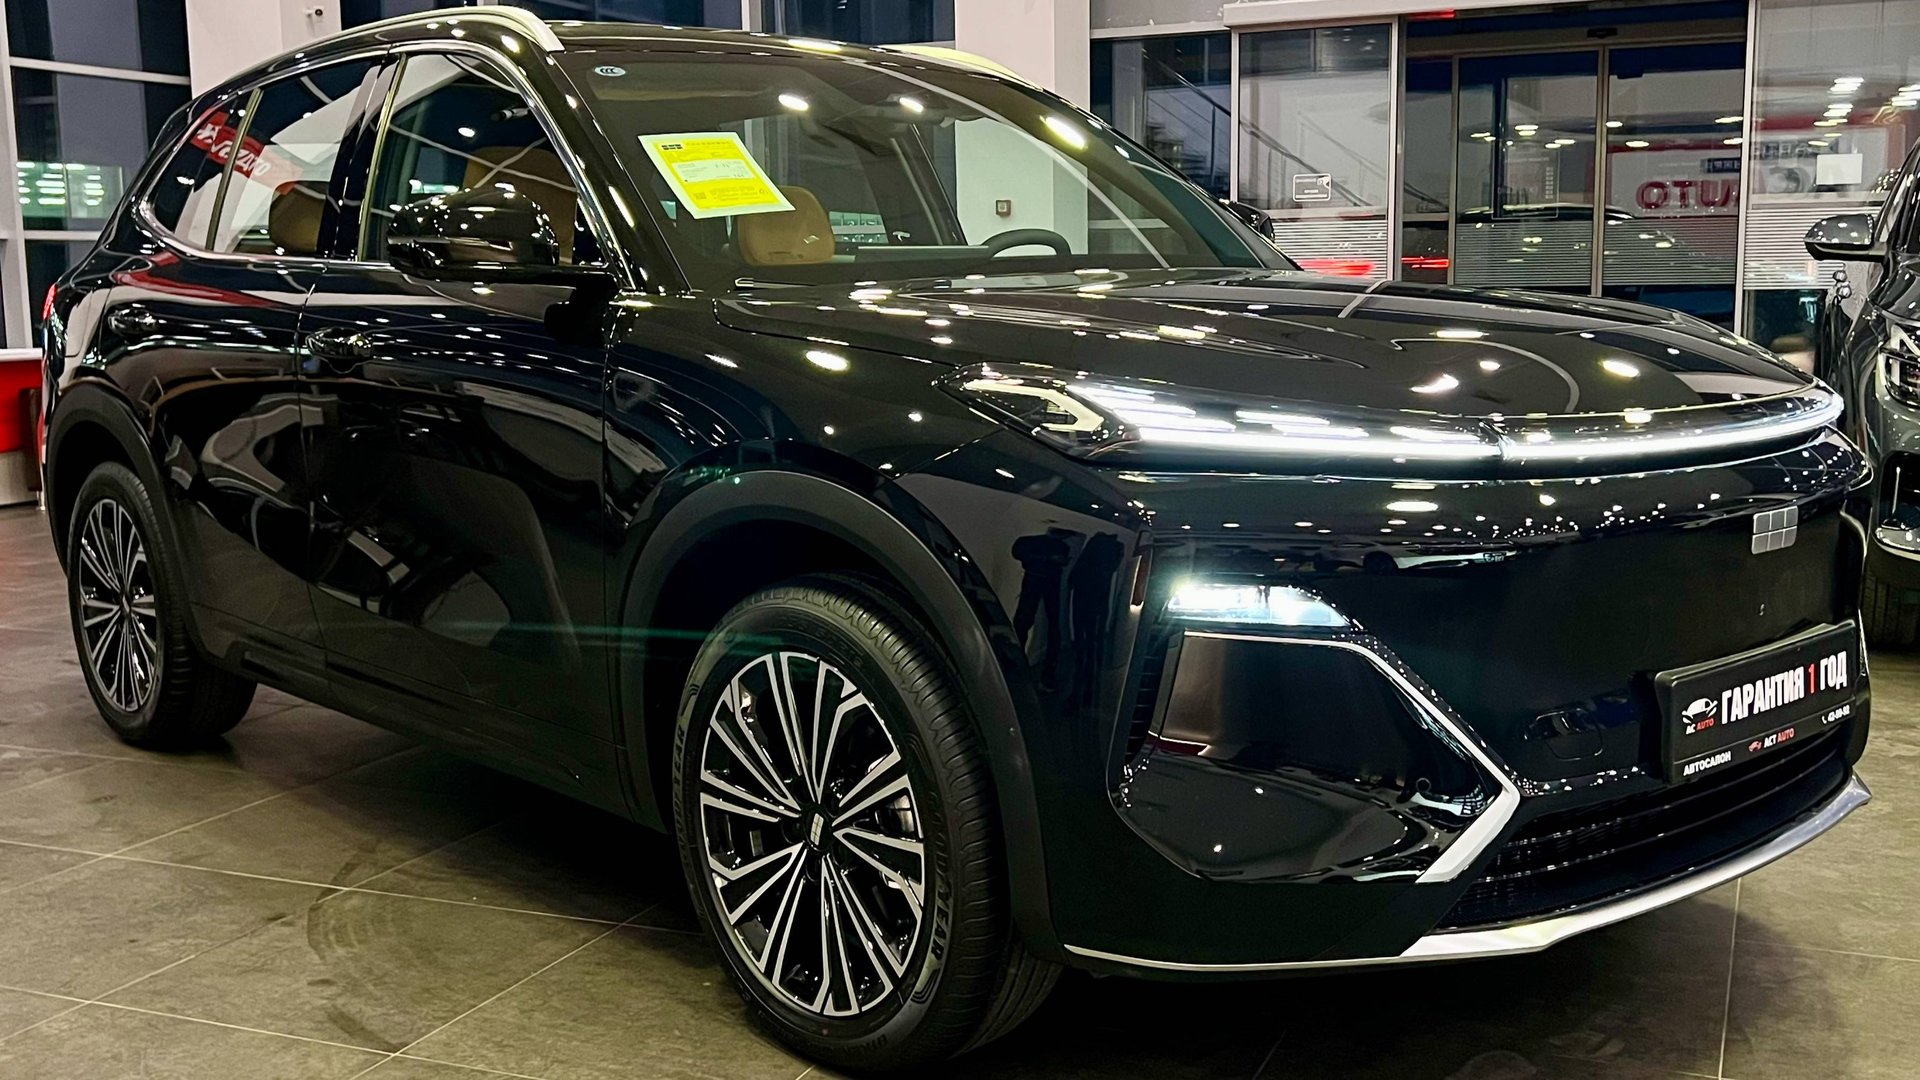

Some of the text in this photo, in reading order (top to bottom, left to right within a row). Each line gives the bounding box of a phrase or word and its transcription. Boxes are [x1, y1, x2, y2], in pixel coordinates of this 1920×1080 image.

[1721, 651, 1848, 725] ГАРАНТИЯ 1 ГОД
[1685, 717, 1715, 735] AC AUTO
[1777, 727, 1795, 742] AUTO
[1683, 750, 1732, 776] АВТОСАЛОН
